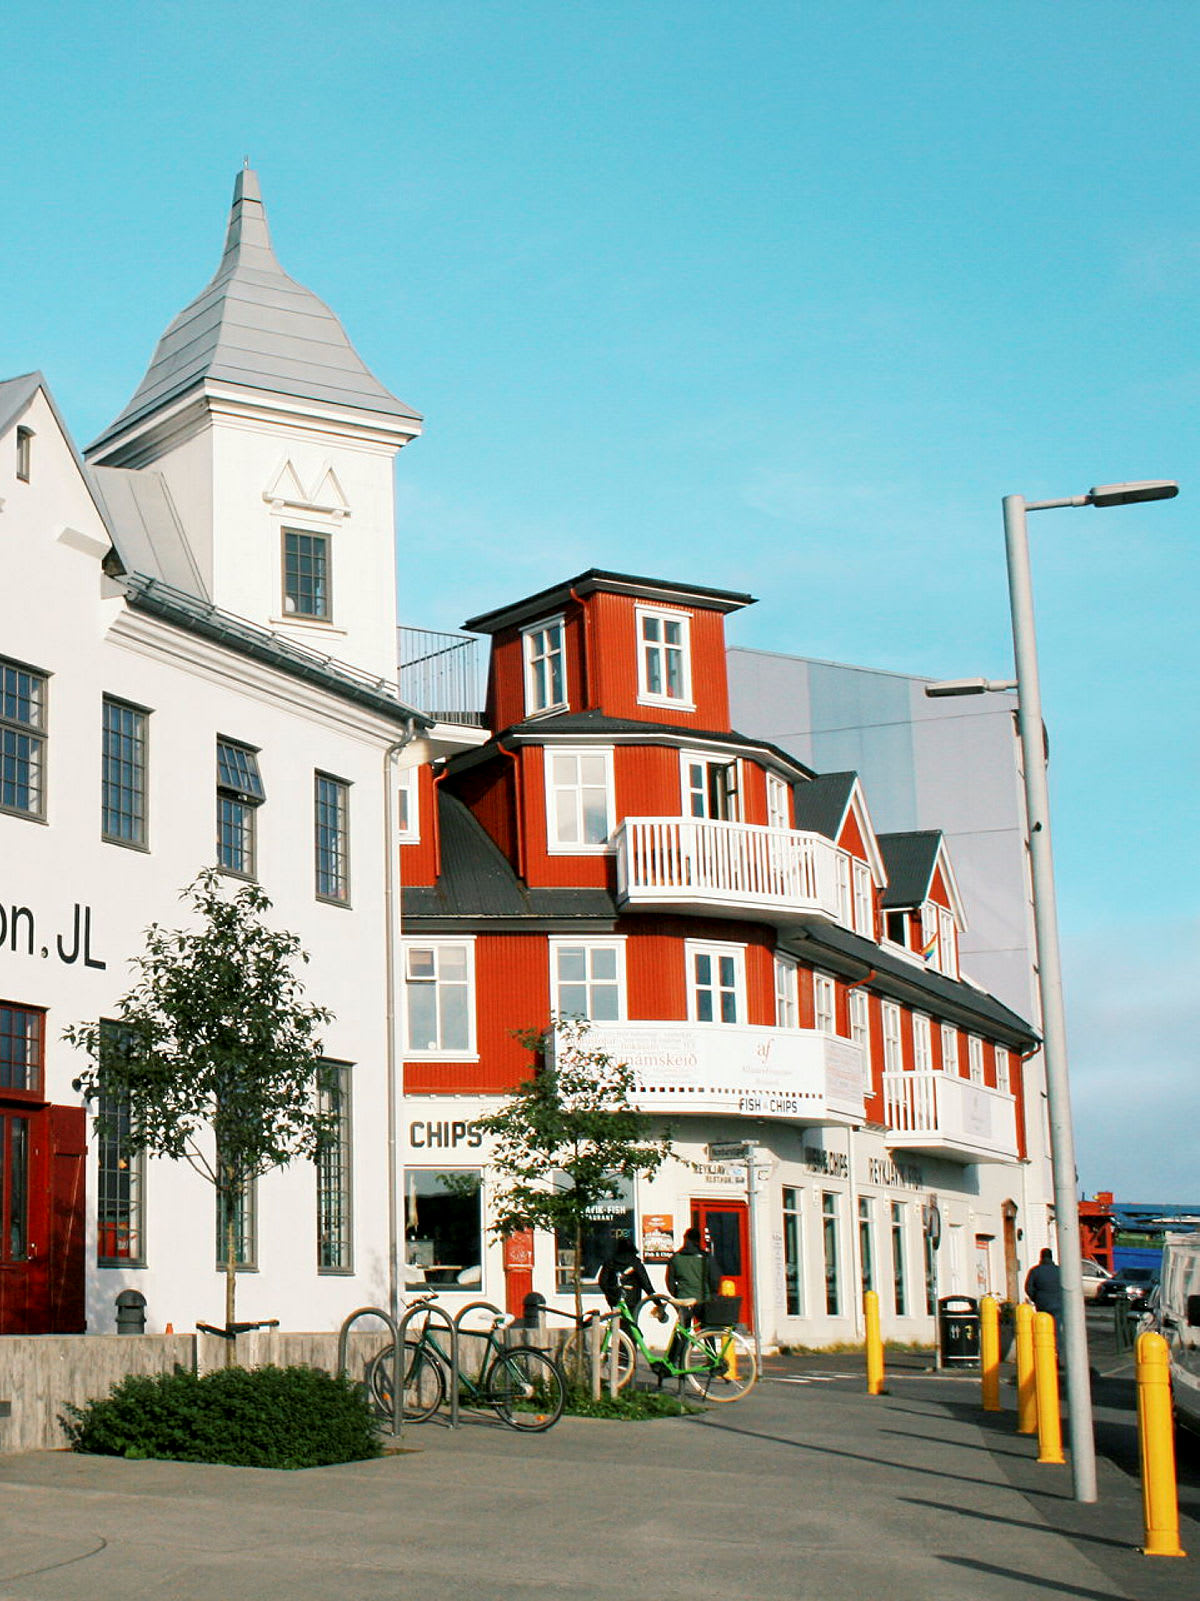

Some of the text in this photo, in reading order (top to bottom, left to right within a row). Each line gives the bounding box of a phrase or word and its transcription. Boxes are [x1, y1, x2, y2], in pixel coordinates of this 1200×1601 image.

[739, 1097, 761, 1111] FISH
[770, 1099, 798, 1113] CHIPS
[410, 1121, 482, 1148] CHIPS
